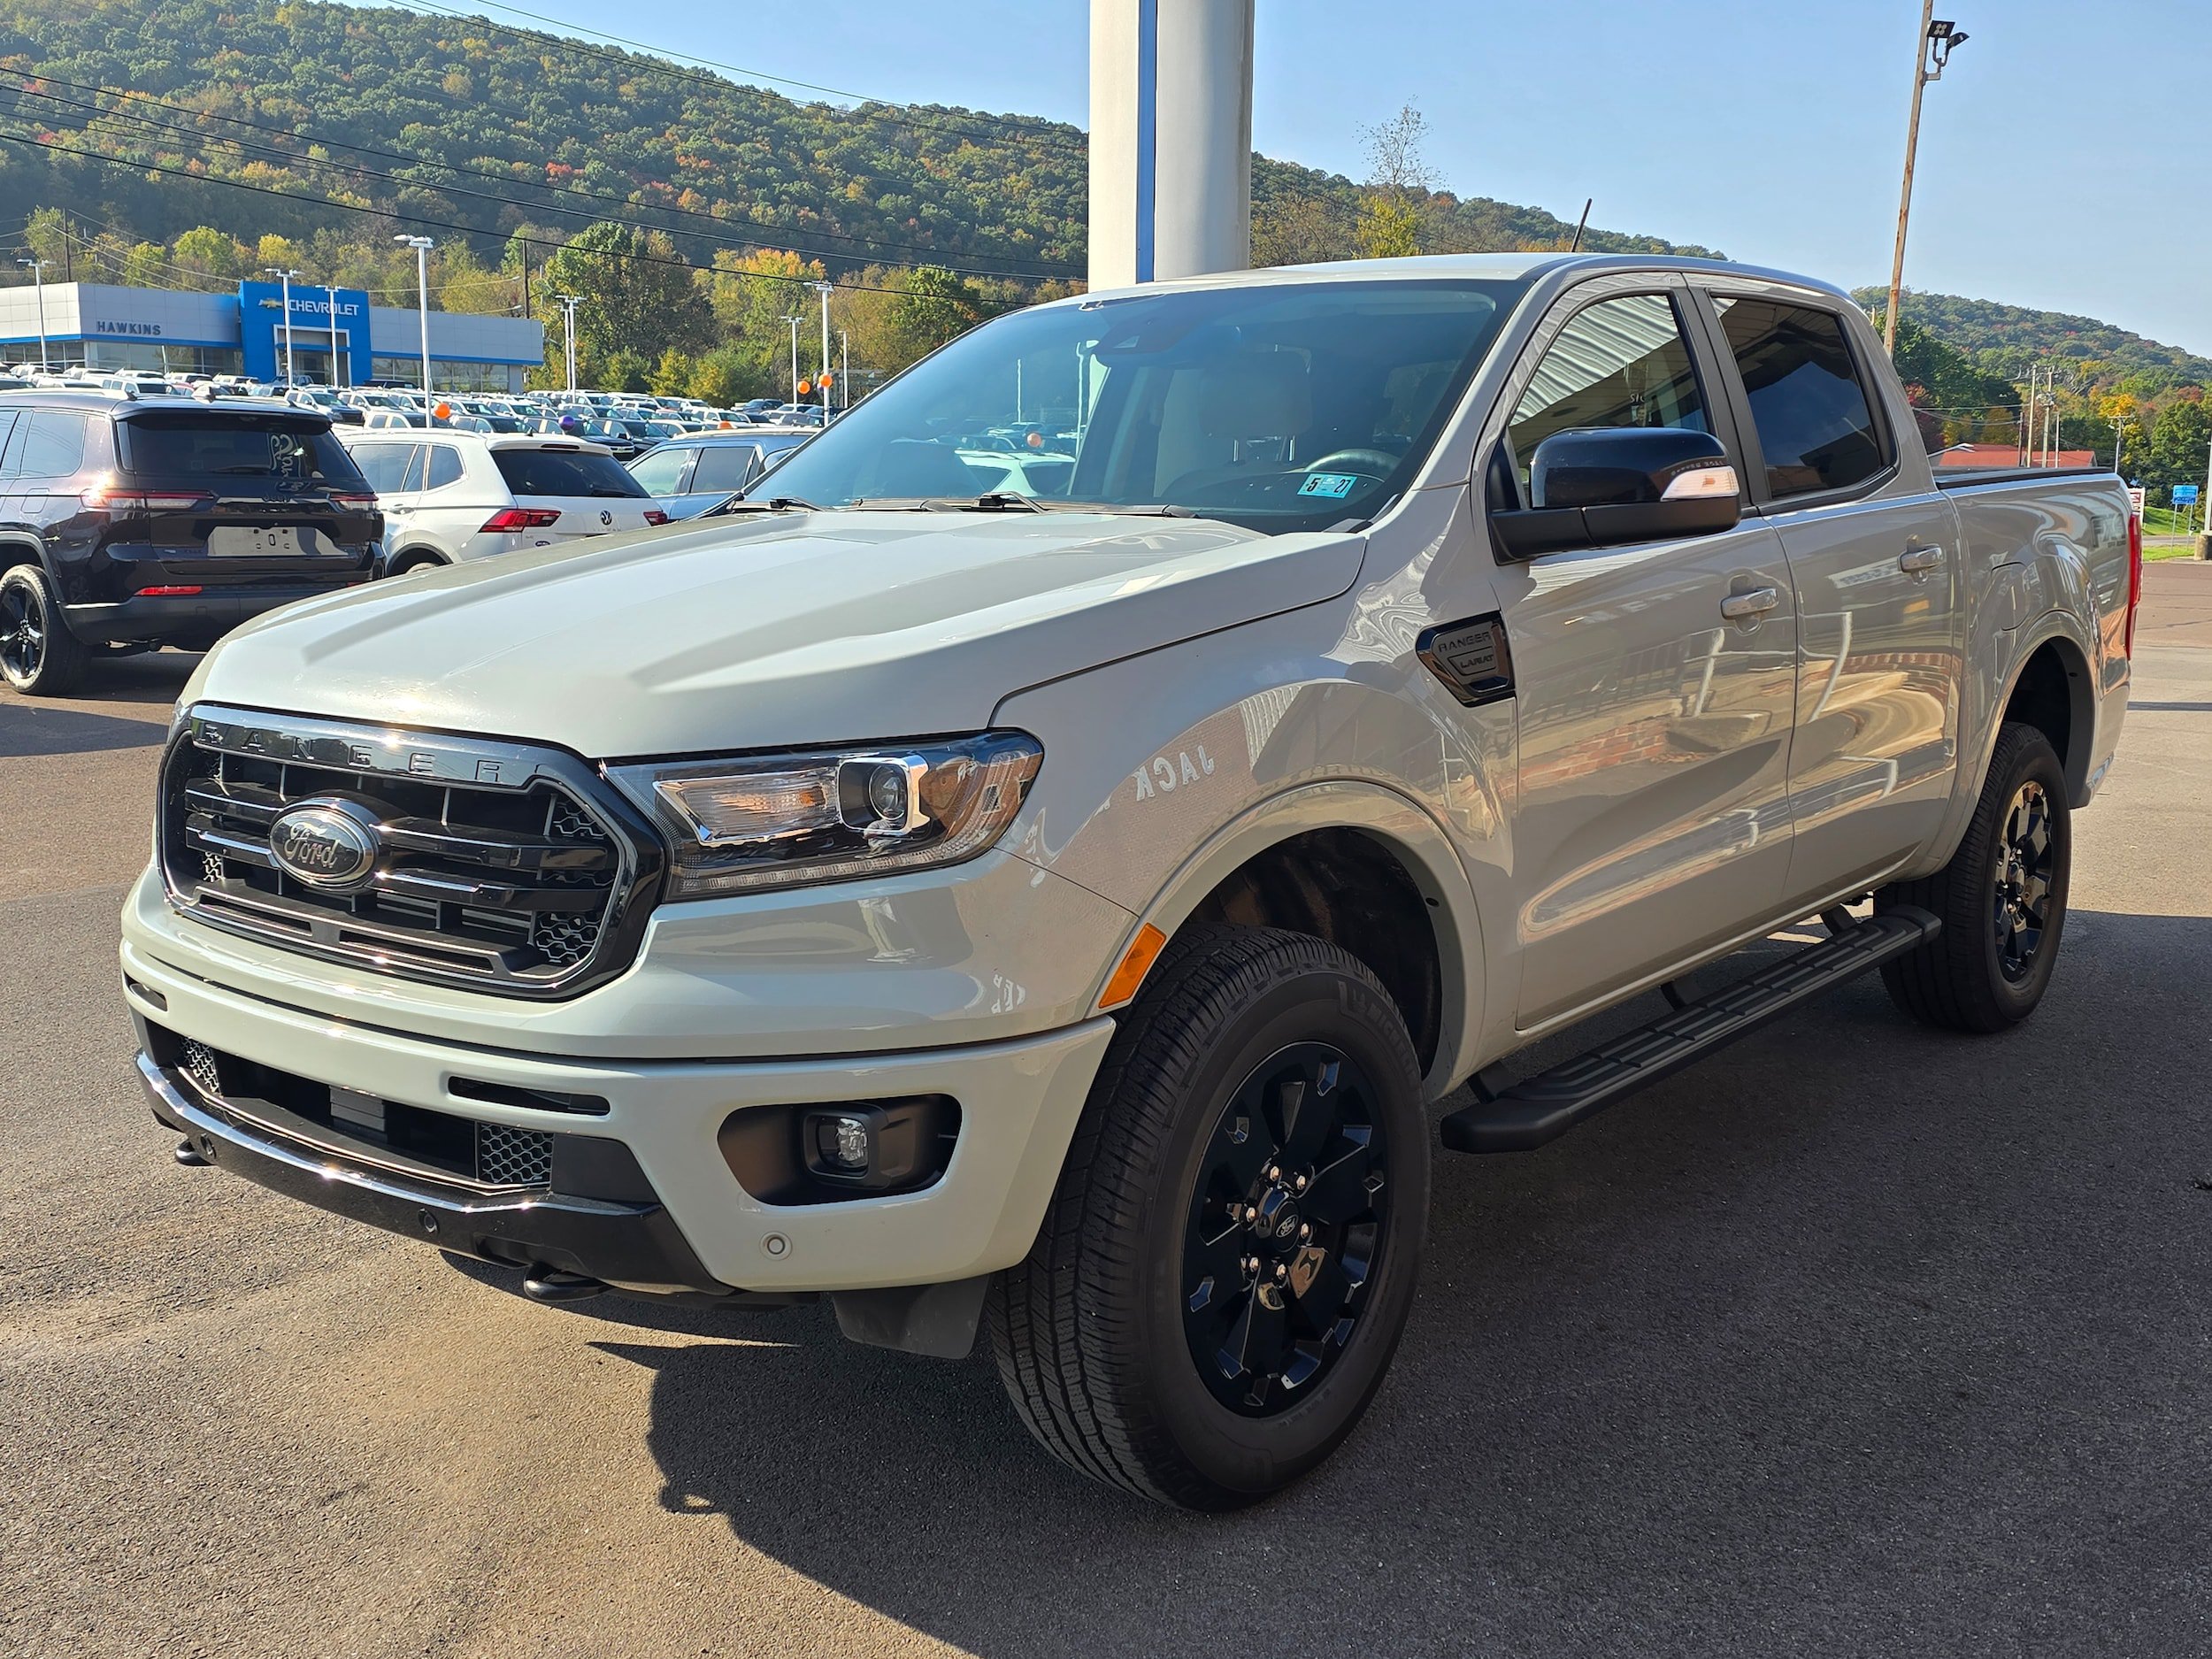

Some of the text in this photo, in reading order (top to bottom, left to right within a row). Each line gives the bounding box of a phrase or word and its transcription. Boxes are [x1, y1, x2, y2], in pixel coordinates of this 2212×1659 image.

[96, 320, 161, 335] HAWKINS
[1306, 478, 1322, 492] 5
[1334, 479, 1352, 494] 27
[1438, 631, 1492, 653] RANGER
[1460, 654, 1494, 669] LARIAT
[203, 723, 504, 783] RANGER
[283, 821, 341, 869] Ford
